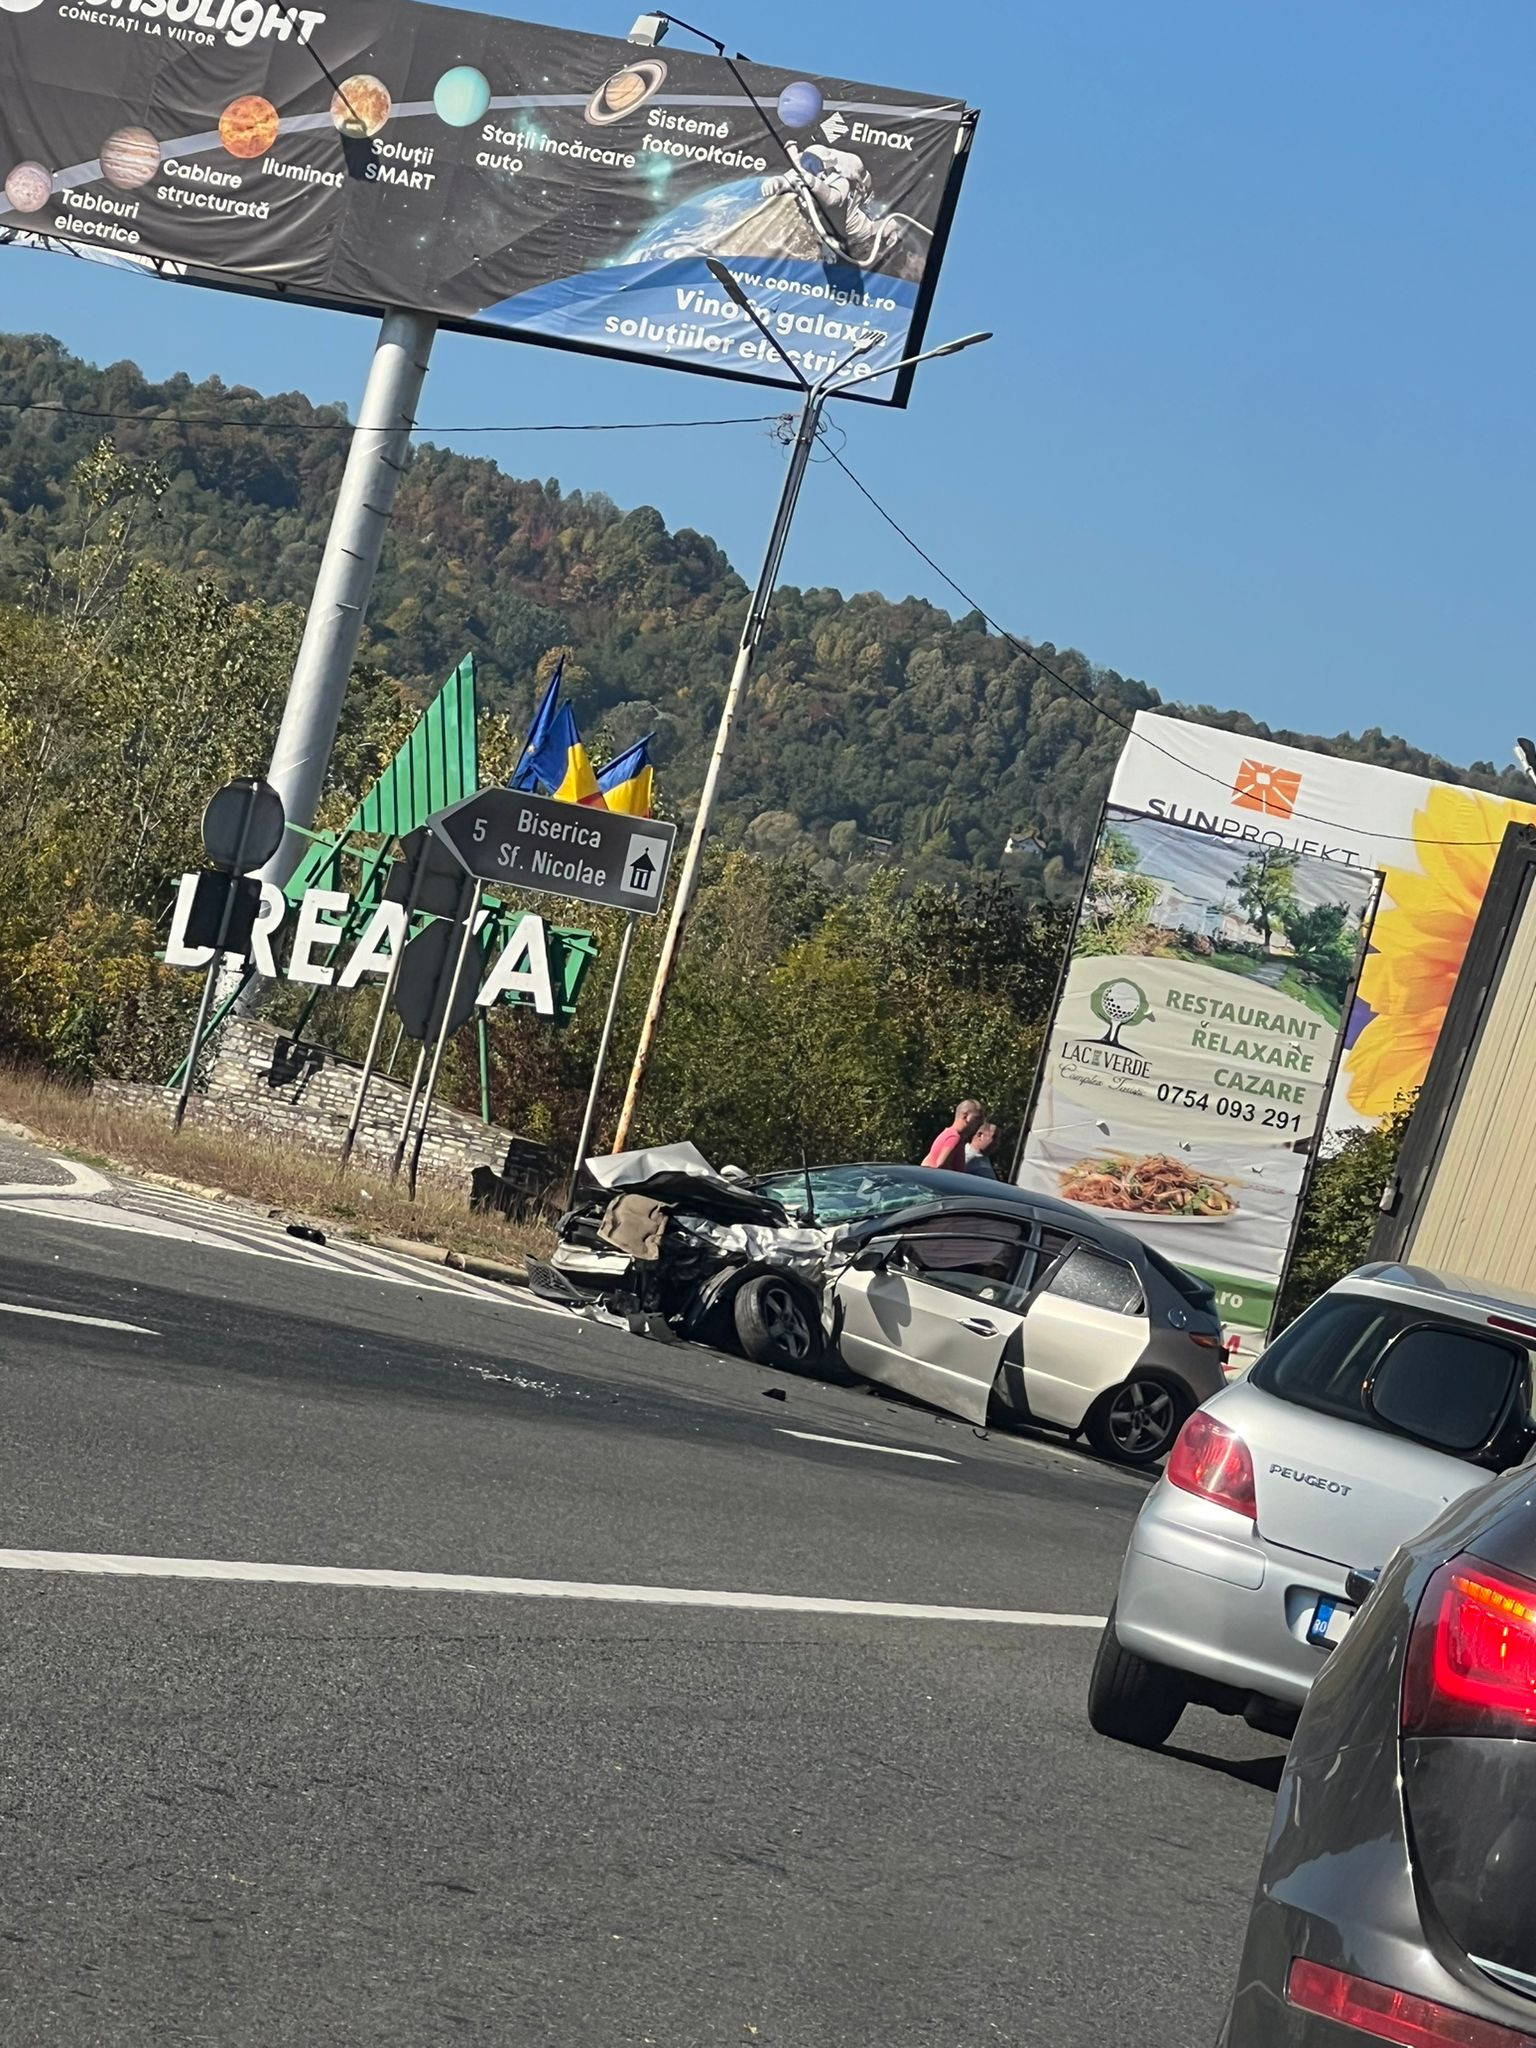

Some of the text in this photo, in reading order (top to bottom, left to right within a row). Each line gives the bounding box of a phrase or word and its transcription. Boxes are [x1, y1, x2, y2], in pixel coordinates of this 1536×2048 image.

[144, 21, 161, 36] LA
[168, 26, 215, 47] VIITOR
[647, 108, 729, 139] Sisteme
[850, 122, 914, 151] Elmax
[475, 151, 523, 172] auto
[539, 134, 636, 169] încărcare
[641, 134, 767, 171] fotovoltaice
[163, 159, 242, 189] Cablare
[262, 157, 344, 189] Iluminat
[364, 163, 436, 191] SMART
[61, 188, 140, 219] Tablouri
[157, 185, 270, 219] structurată
[54, 213, 140, 244] electrice
[676, 288, 739, 320] Vino
[472, 818, 488, 842] 5
[517, 809, 601, 848] Biserica
[1147, 798, 1360, 867] SUNPROJEKT
[497, 843, 607, 887] Sf. Nicolae
[1166, 989, 1322, 1040] RESTAURANT
[1061, 1042, 1092, 1064] LAC
[1104, 1052, 1153, 1079] VERDE
[1191, 1029, 1314, 1073] RELAXARE
[1214, 1069, 1306, 1105] CAZARE
[1157, 1084, 1301, 1132] 0754 093 291
[1269, 1463, 1353, 1497] PEUGEOT
